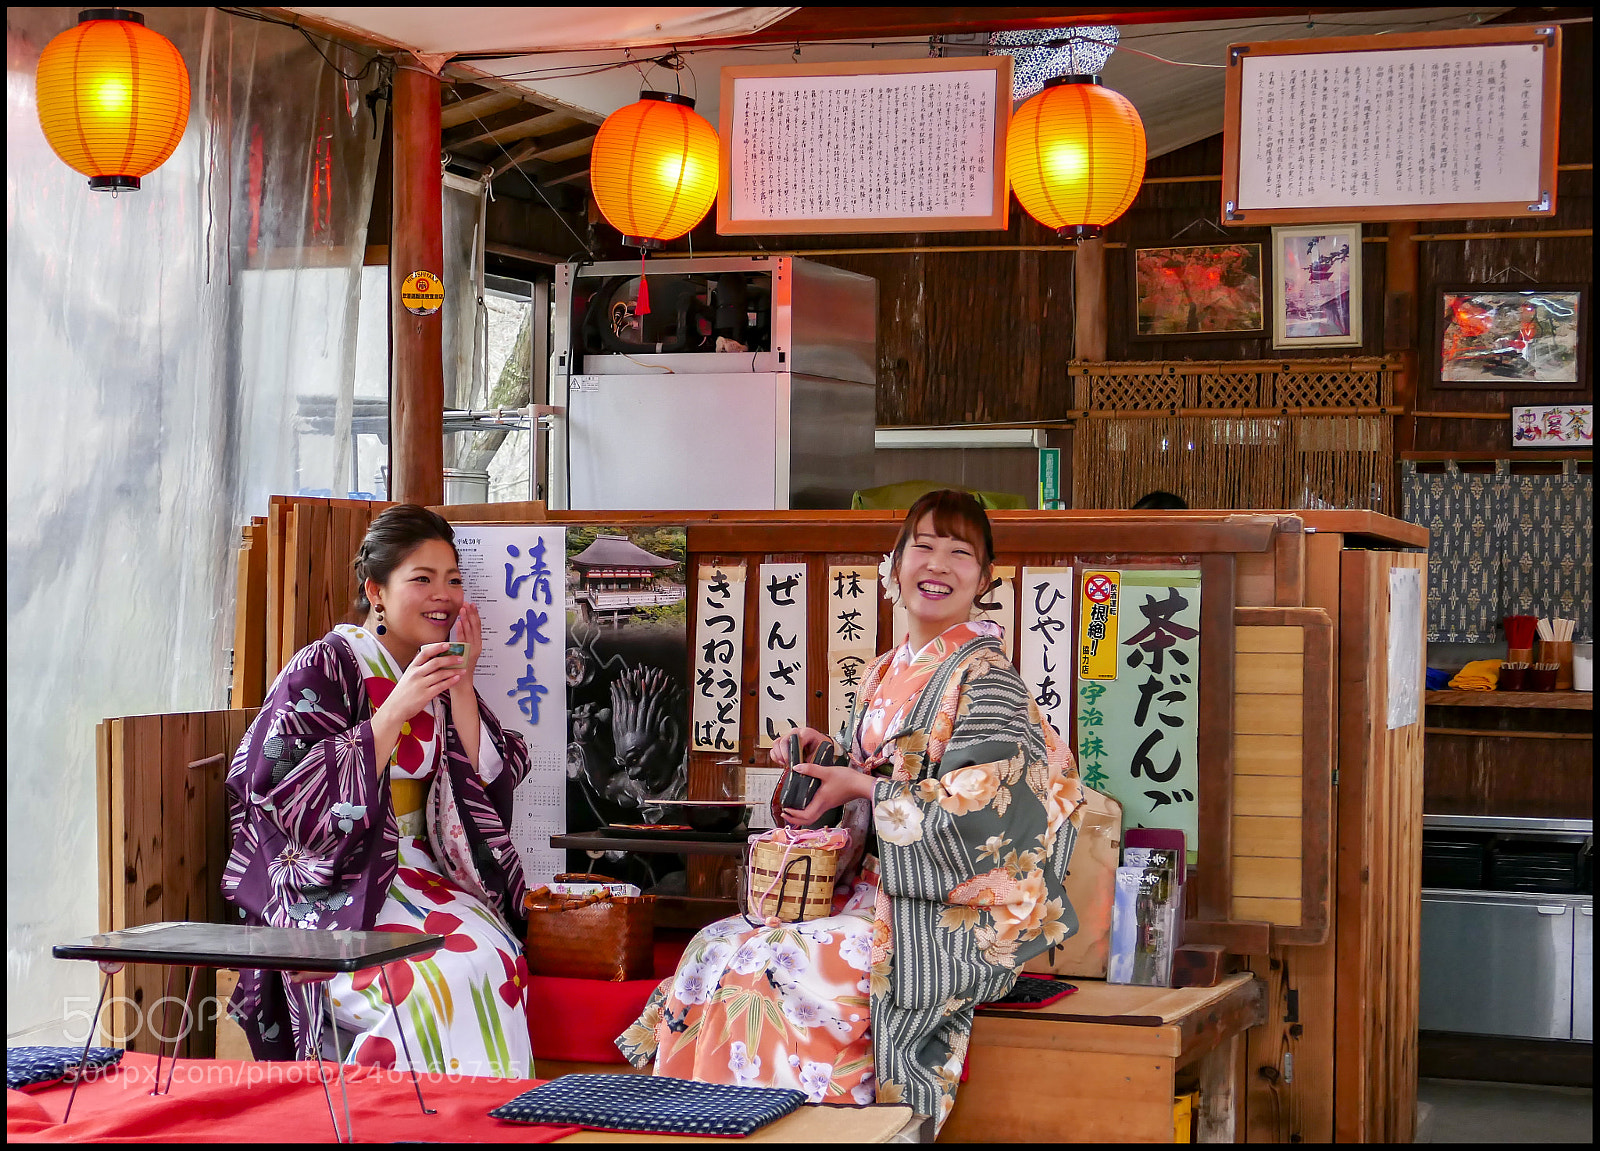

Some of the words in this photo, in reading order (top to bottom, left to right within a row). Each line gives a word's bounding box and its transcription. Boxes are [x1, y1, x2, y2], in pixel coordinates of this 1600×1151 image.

[505, 536, 553, 725] 清水寺
[1109, 583, 1118, 616] 飲酒運転
[766, 572, 802, 741] ぜんざい
[1081, 645, 1090, 675] 協力店
